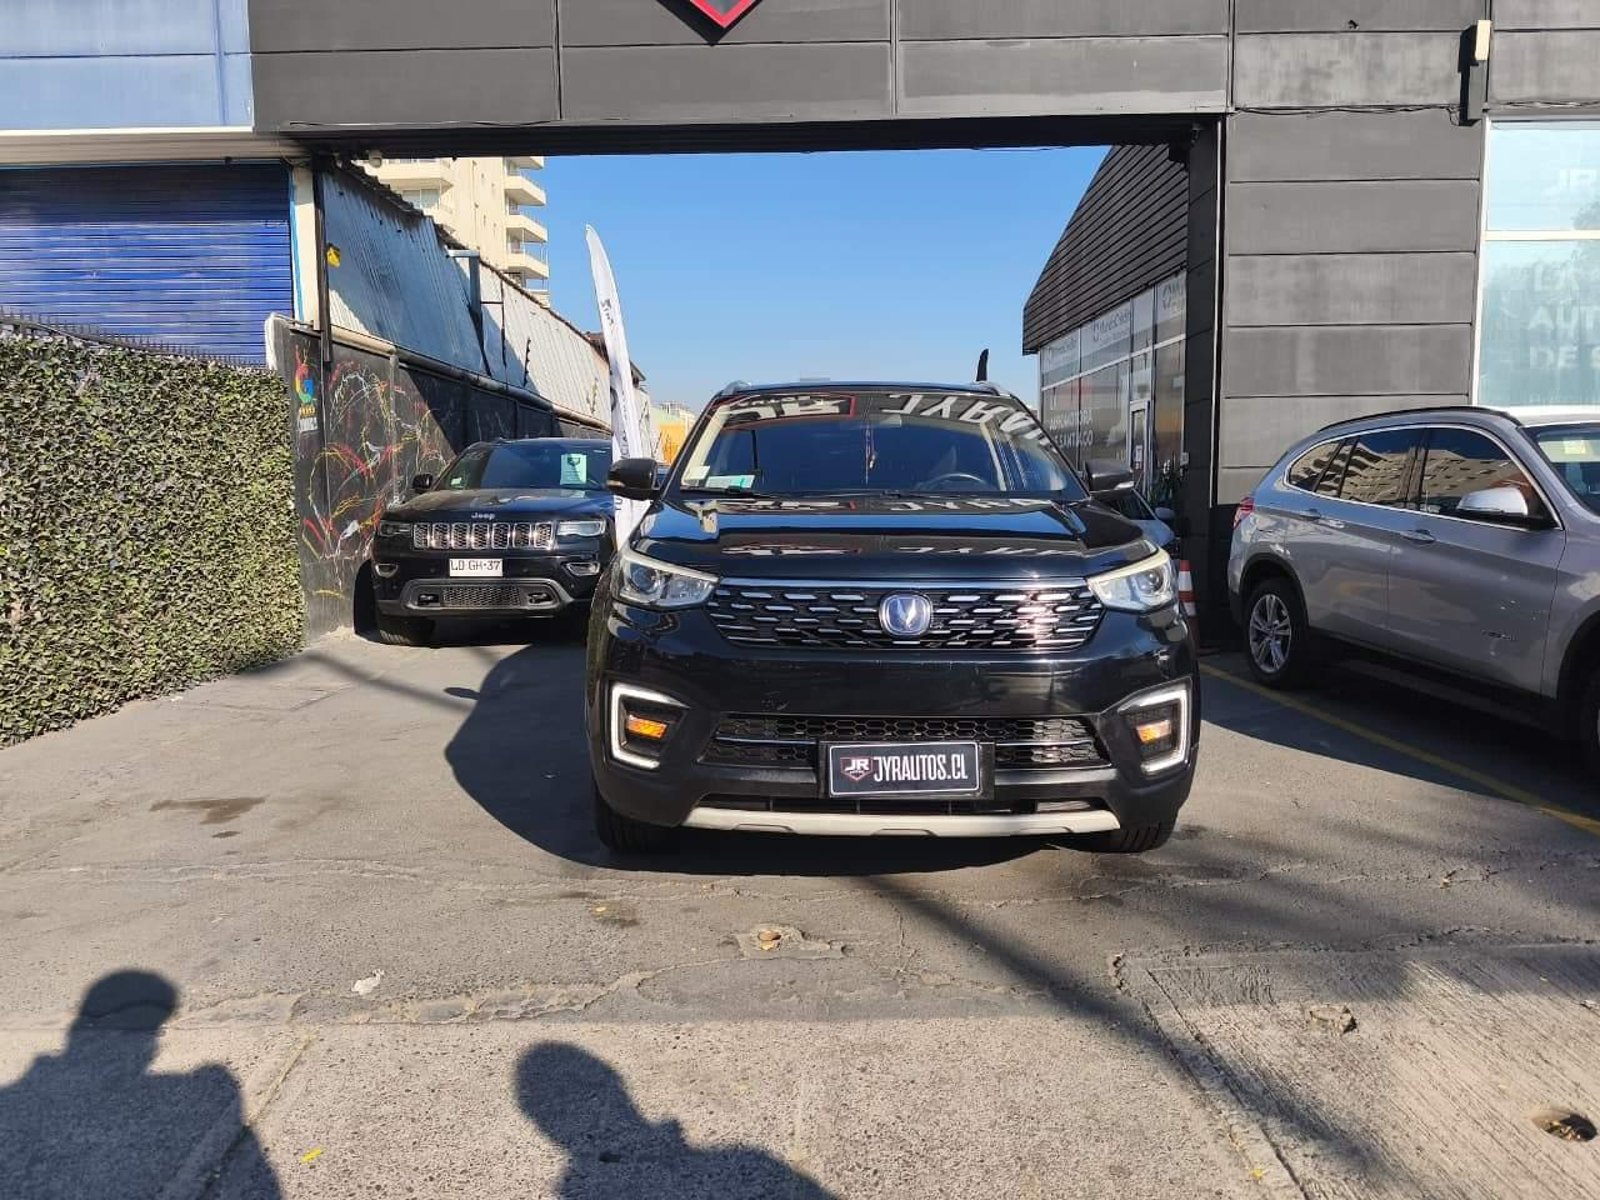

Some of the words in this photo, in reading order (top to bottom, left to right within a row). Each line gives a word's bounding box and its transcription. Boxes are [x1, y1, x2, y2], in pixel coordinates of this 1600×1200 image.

[1529, 346, 1579, 369] DE
[471, 512, 496, 520] Jeep
[450, 560, 465, 571] LD
[845, 759, 869, 771] JR
[873, 753, 968, 782] JYRAUTOS.CL
